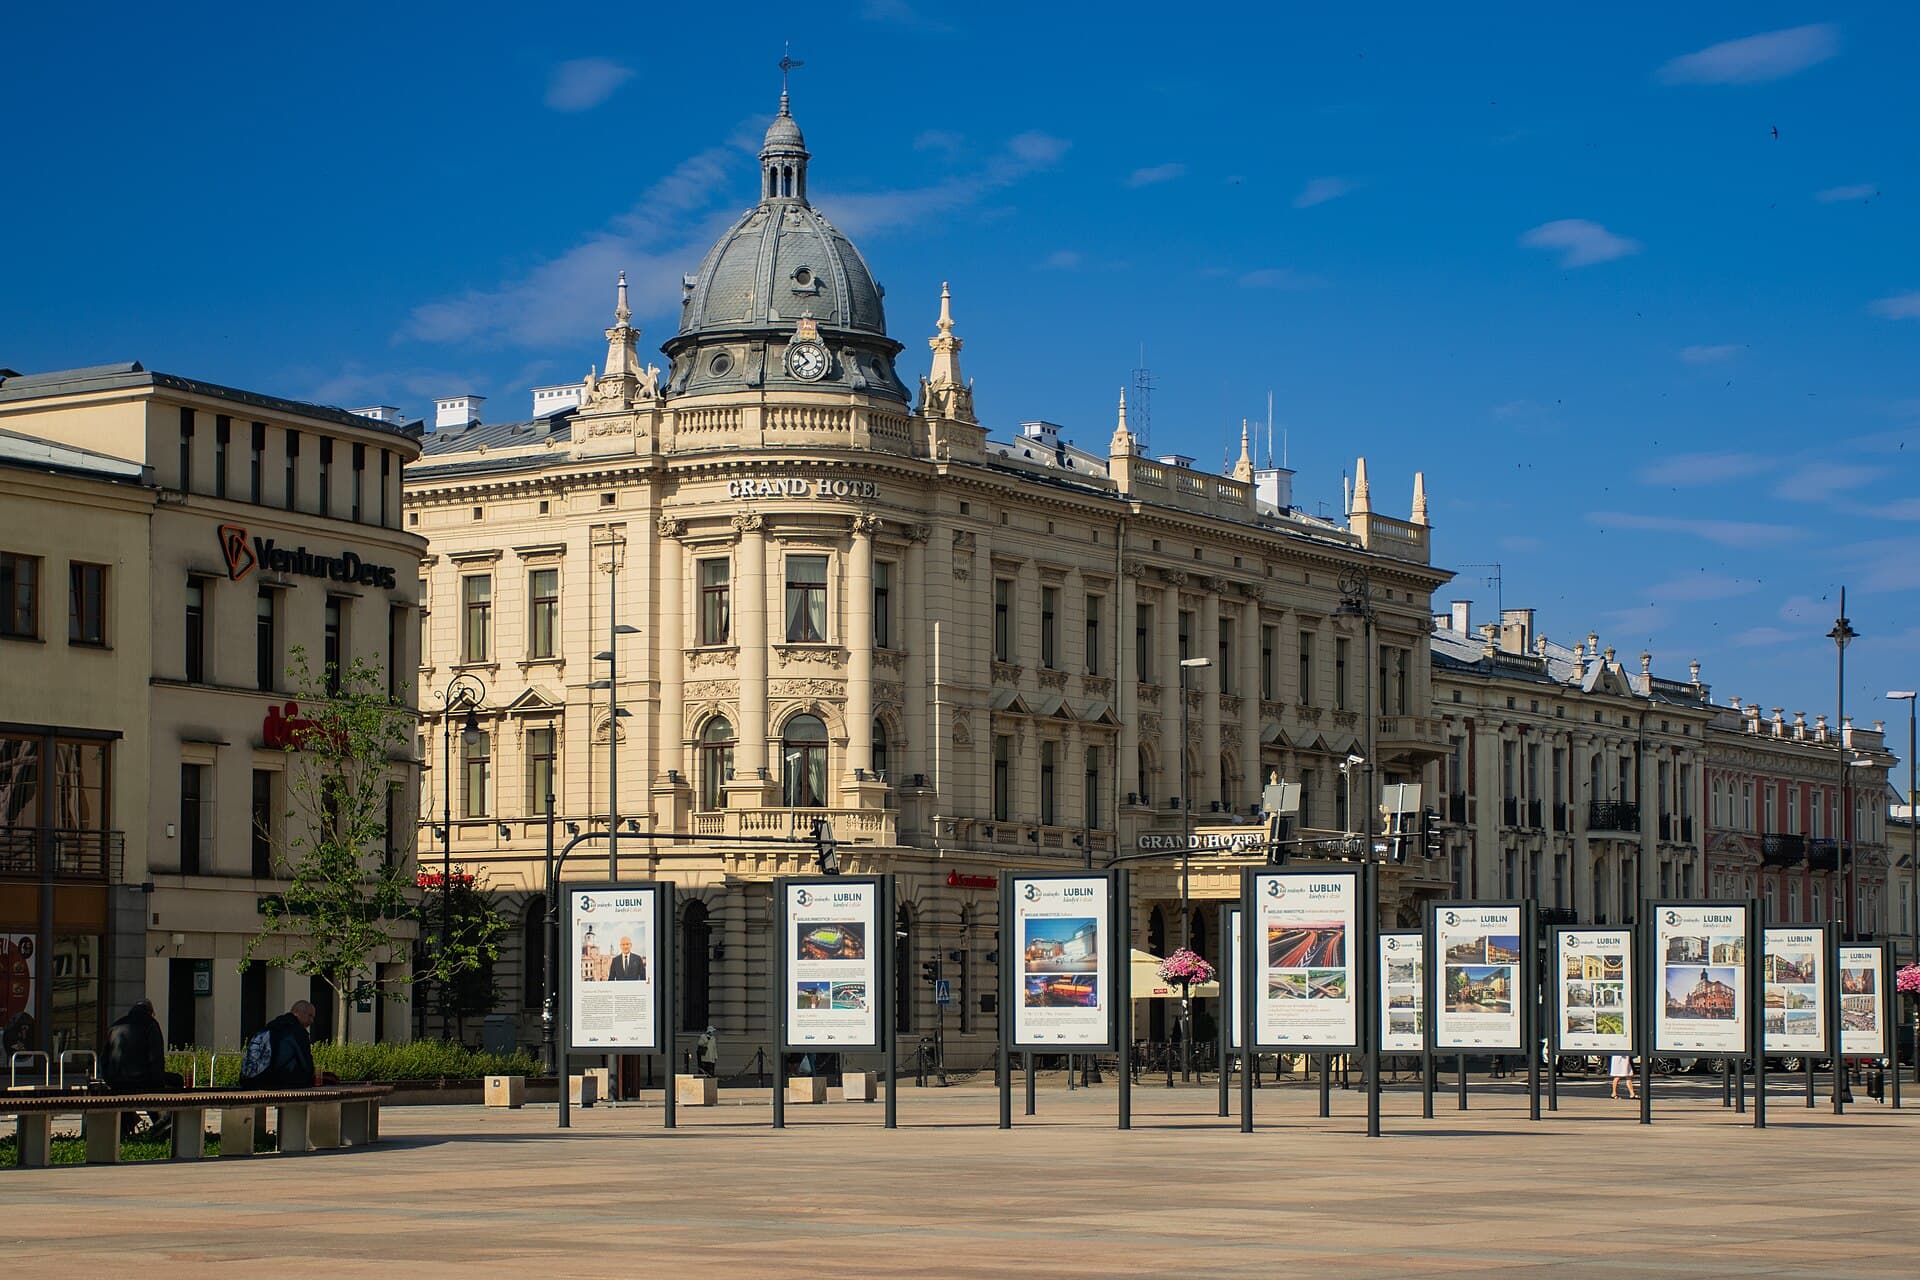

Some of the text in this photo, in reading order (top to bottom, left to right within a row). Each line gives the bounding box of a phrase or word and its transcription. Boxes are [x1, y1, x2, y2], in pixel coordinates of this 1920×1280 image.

[727, 477, 881, 499] GRAND HOTEL
[253, 536, 396, 589] VentureDevs
[1138, 832, 1265, 849] GRAND HOTEL
[1063, 887, 1093, 896] LUBLIN
[1309, 883, 1341, 893] LUBLIN
[833, 893, 862, 902] LUBLIN
[615, 898, 642, 907] LUBLIN
[1480, 915, 1508, 923] LUBLIN
[1703, 915, 1732, 923] LUBLIN
[1597, 937, 1621, 945] LUBLIN
[1787, 935, 1812, 943] LUBLIN
